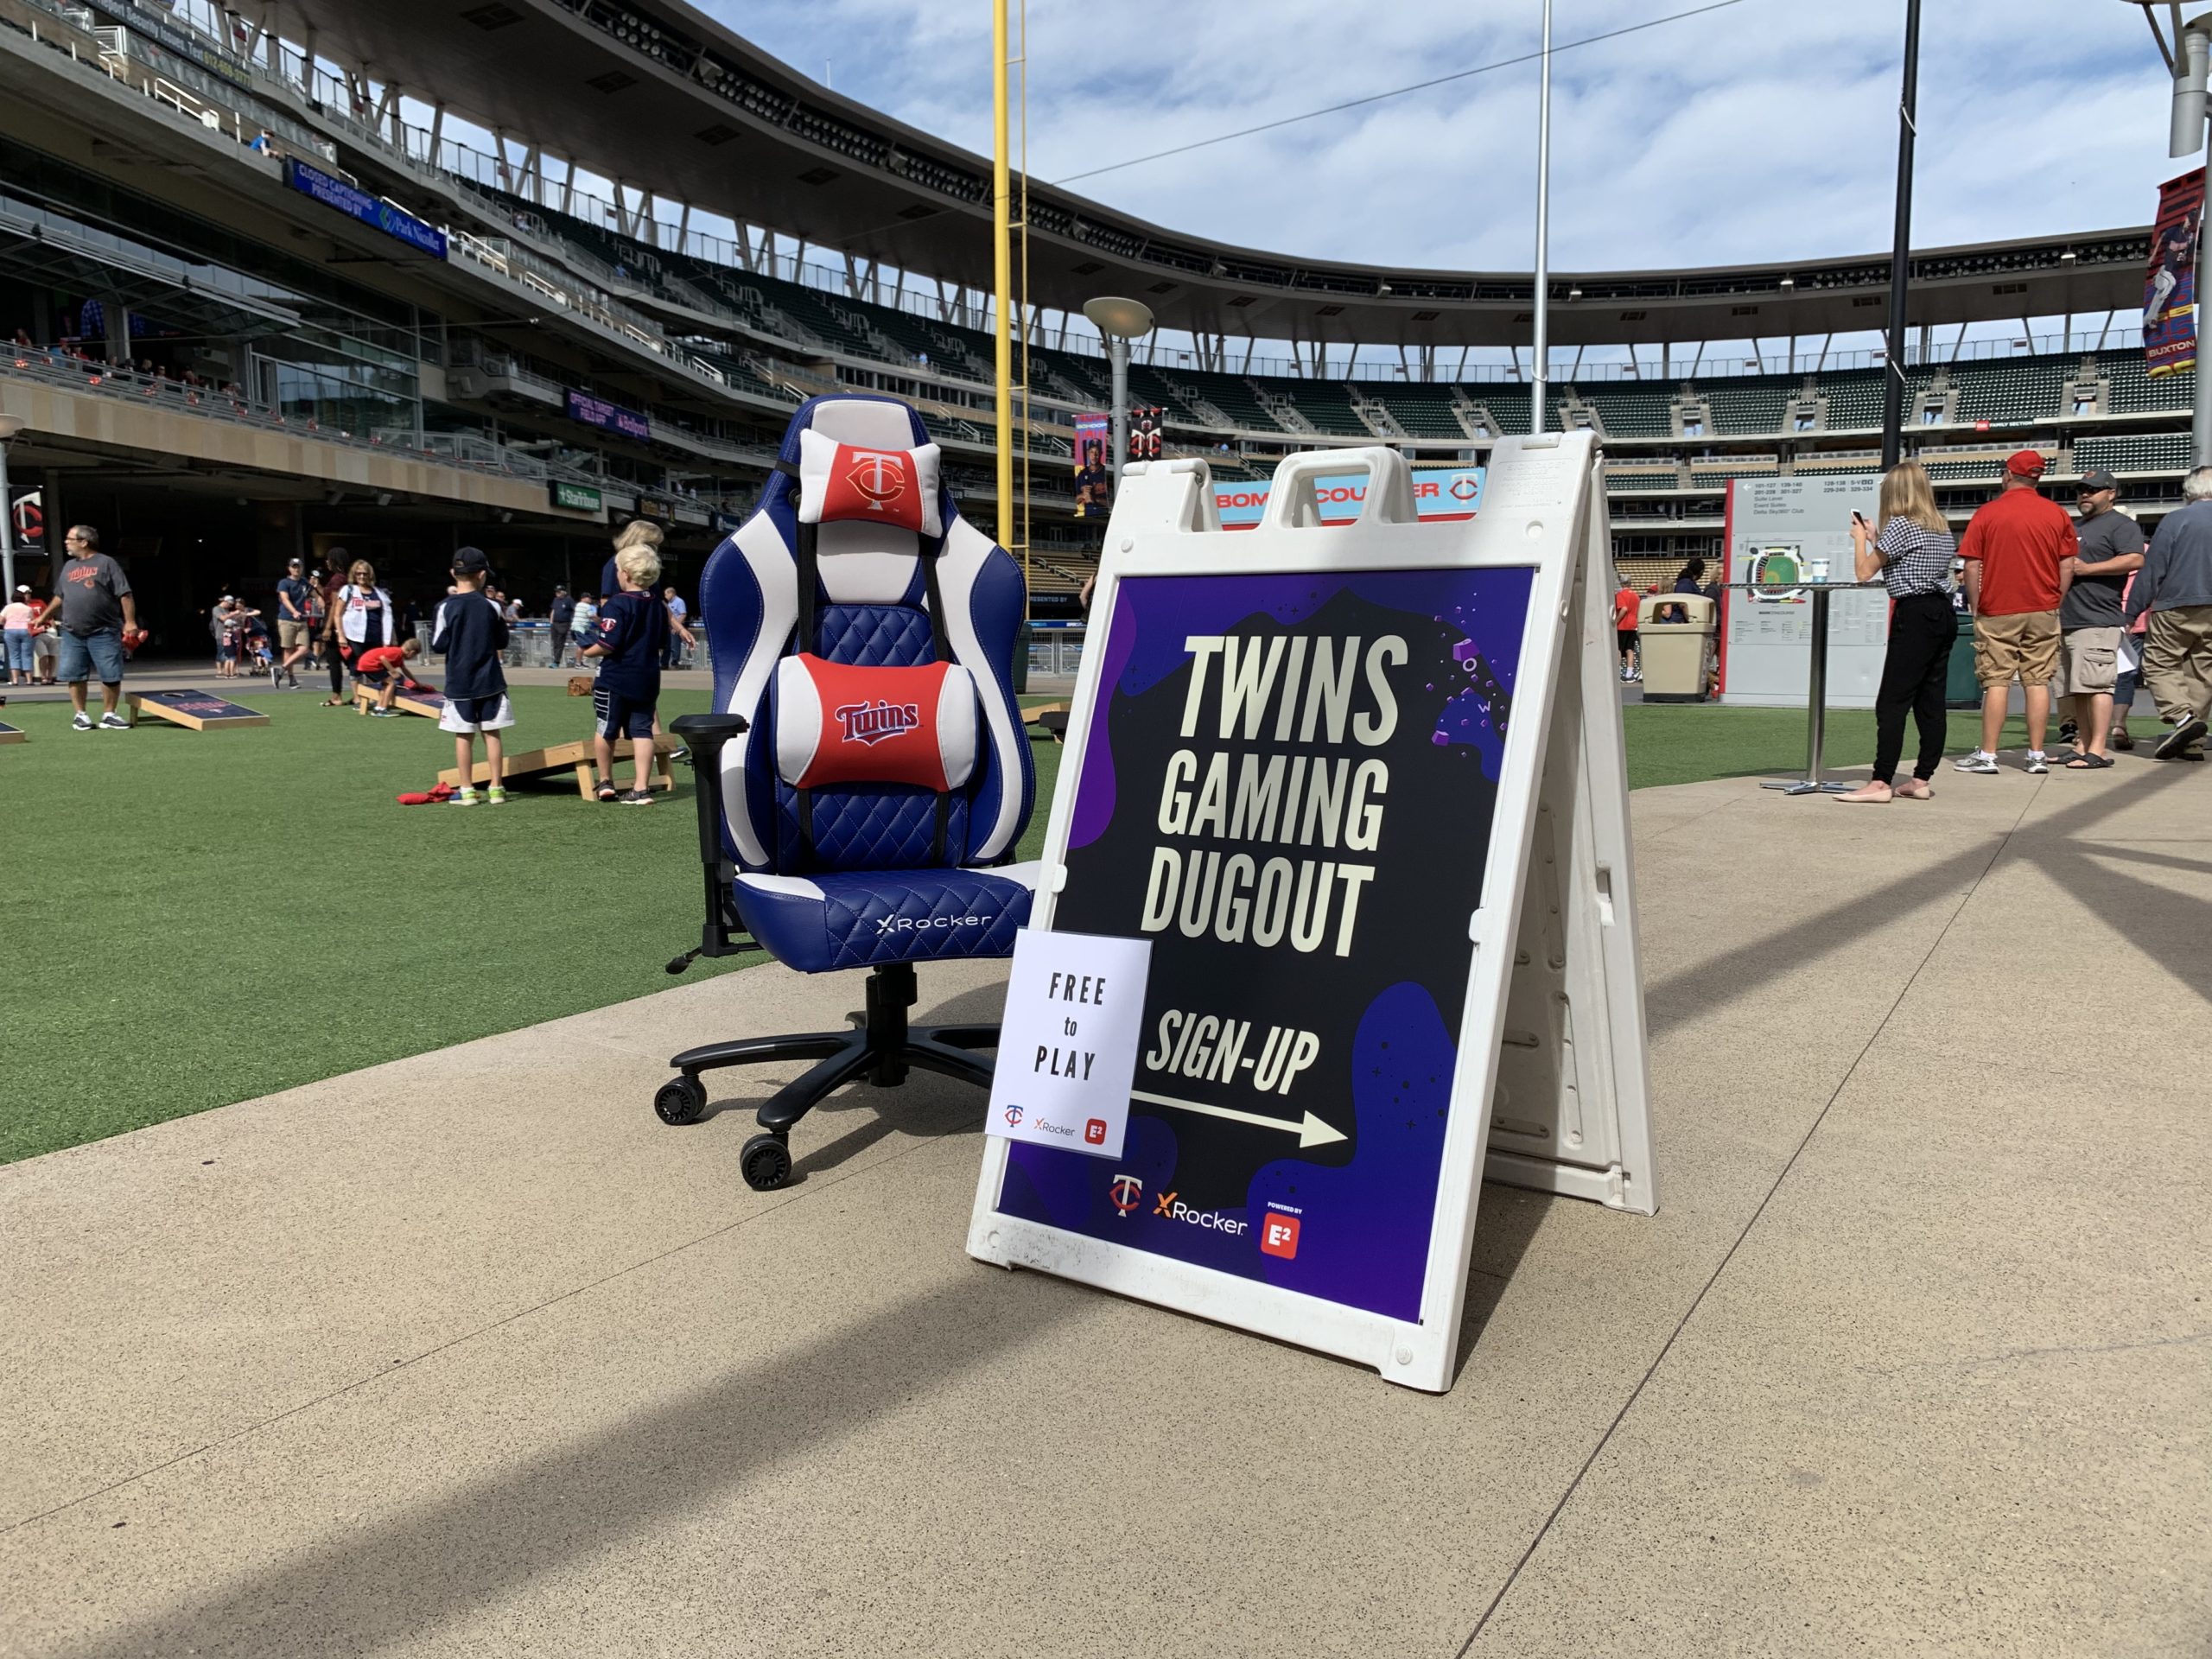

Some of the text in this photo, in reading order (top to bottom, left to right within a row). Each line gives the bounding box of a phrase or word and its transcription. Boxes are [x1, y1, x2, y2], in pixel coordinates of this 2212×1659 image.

[299, 164, 373, 210] CLOSED CAPTIONING
[312, 183, 362, 216] PRESENTED BY
[397, 216, 440, 251] Park Nicollet
[2149, 340, 2196, 357] BUXTON
[1216, 492, 1270, 508] BOM
[1179, 634, 1408, 747] TWINS
[835, 699, 919, 747] Twins
[1157, 749, 1389, 851] GAMING
[1141, 846, 1376, 957] DUGOUT
[1048, 972, 1107, 1006] FREE
[1064, 1015, 1078, 1037] to
[1034, 1046, 1096, 1081] PLAY
[1146, 1009, 1320, 1095] SIGN-UP
[1267, 1201, 1294, 1213] POWERED
